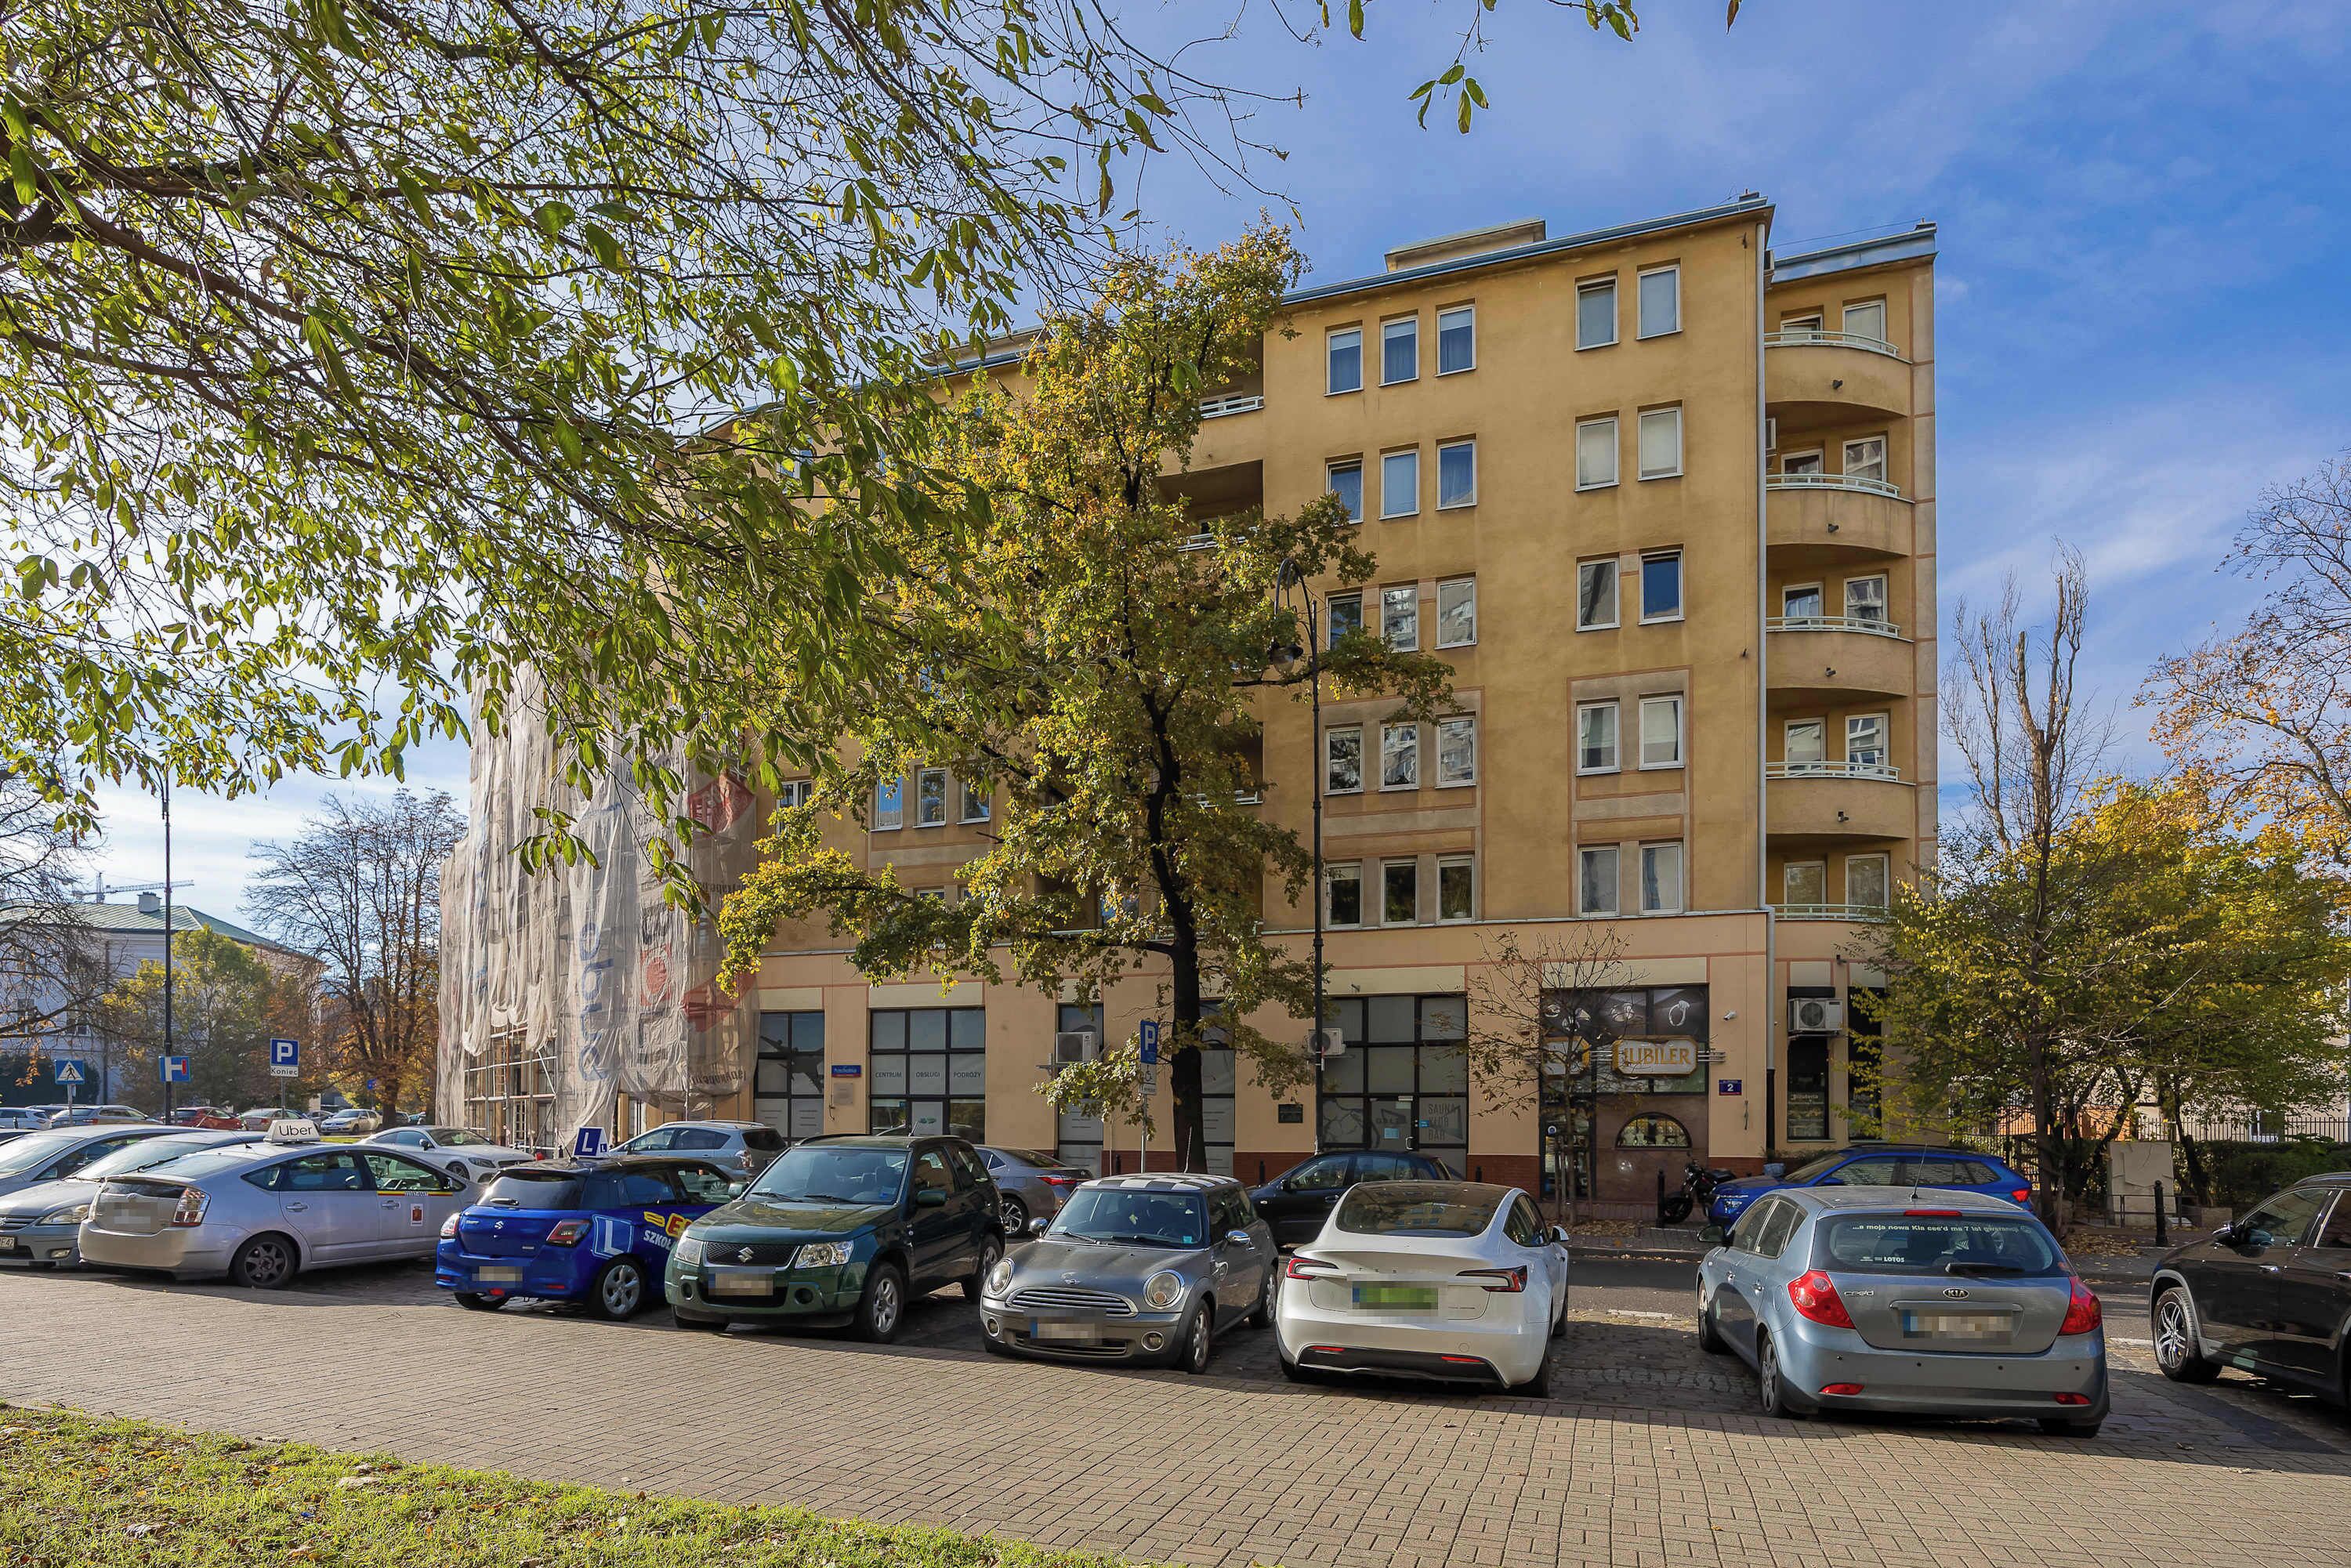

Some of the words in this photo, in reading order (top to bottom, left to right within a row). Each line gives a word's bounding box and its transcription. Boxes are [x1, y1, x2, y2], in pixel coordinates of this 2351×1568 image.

[1144, 1025, 1156, 1051] P
[277, 1041, 293, 1063] P
[1727, 1083, 1733, 1092] 2
[1429, 1103, 1455, 1114] SAUNA
[279, 1124, 313, 1136] Uber
[581, 1132, 593, 1152] L
[603, 1219, 624, 1255] L
